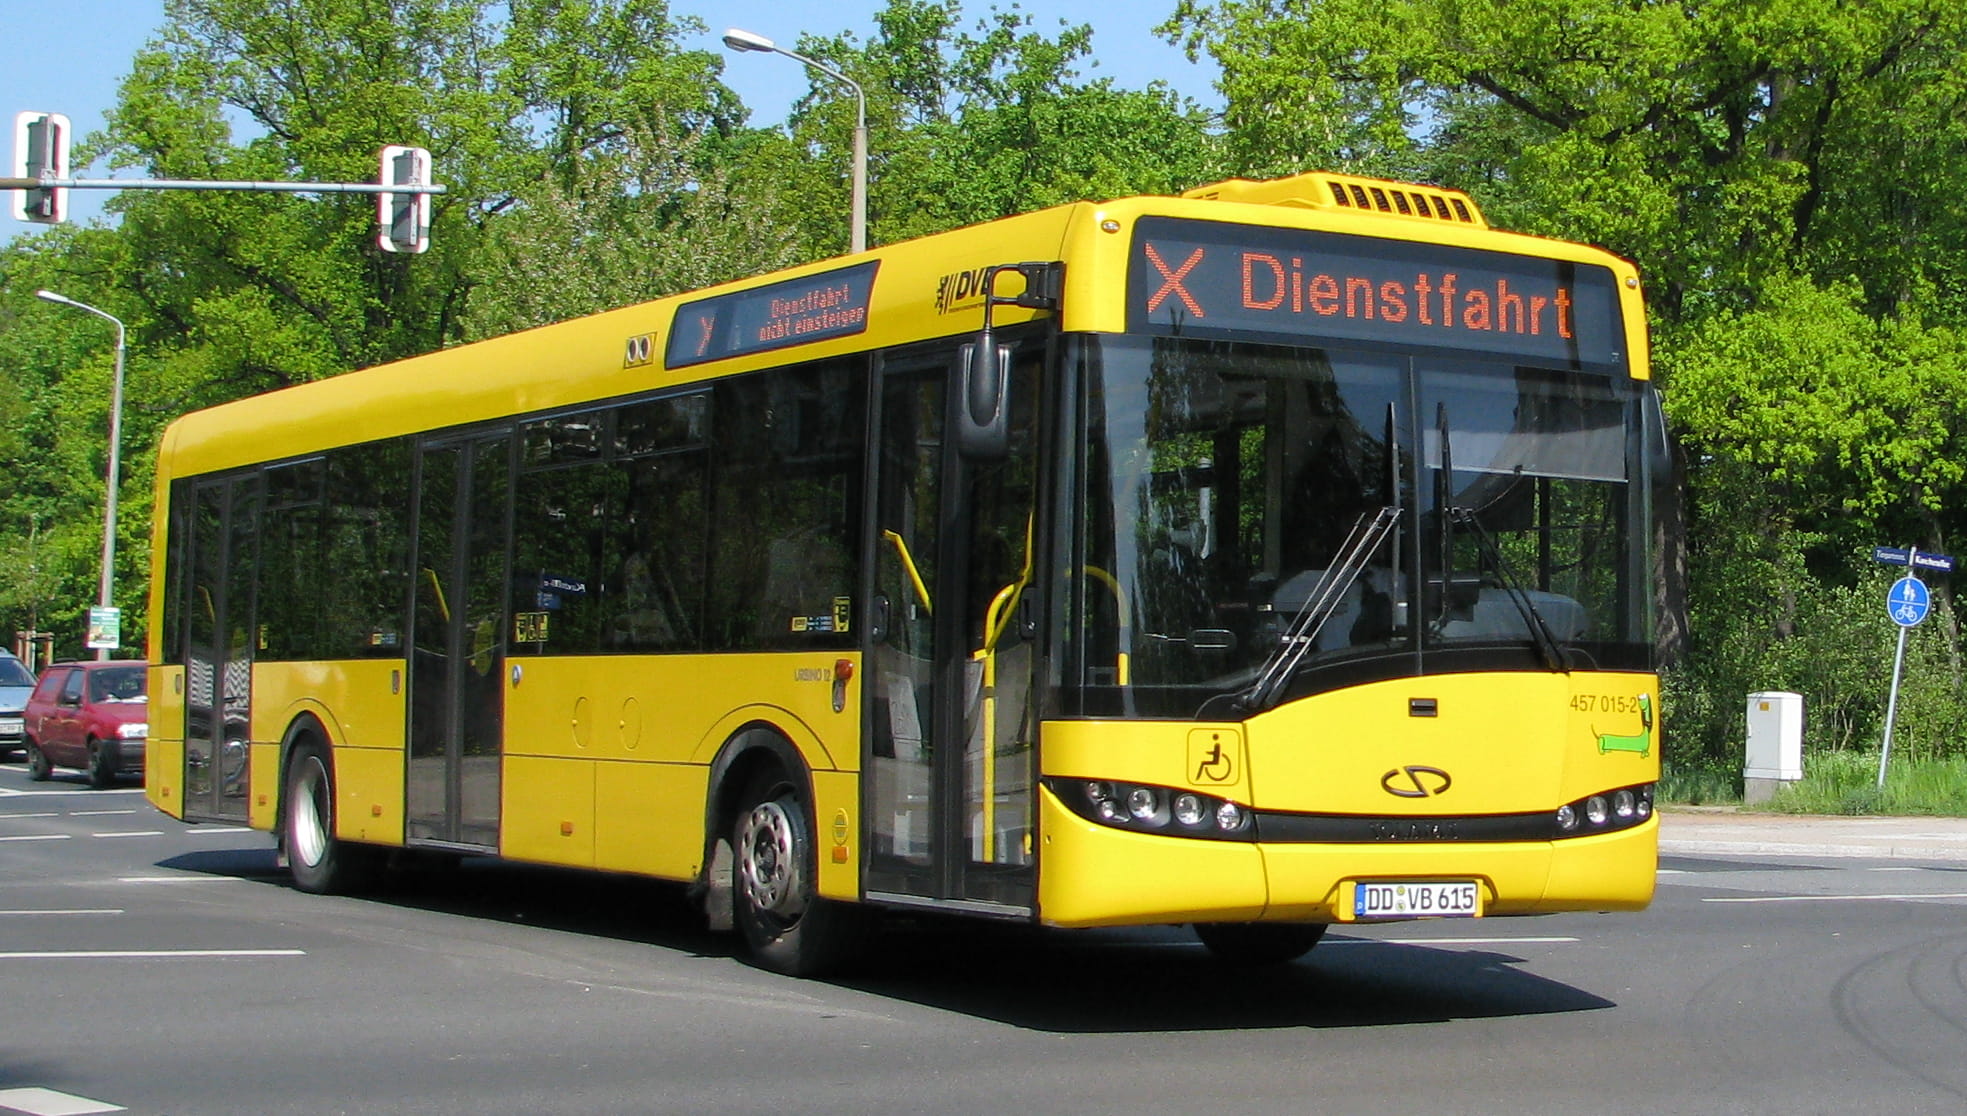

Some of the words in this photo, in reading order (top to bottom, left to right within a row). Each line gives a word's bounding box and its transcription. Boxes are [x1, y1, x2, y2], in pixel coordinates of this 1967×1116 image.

[771, 283, 849, 319] Dienstfahrt
[1144, 242, 1205, 318] X
[1241, 251, 1572, 339] Dienstfahrt
[759, 317, 790, 342] nicht
[795, 306, 865, 335] einsteigen
[1570, 694, 1596, 711] 457
[1601, 695, 1637, 713] 015-2
[1368, 888, 1394, 910] DD
[1408, 888, 1433, 910] VB
[1438, 887, 1474, 910] 615
